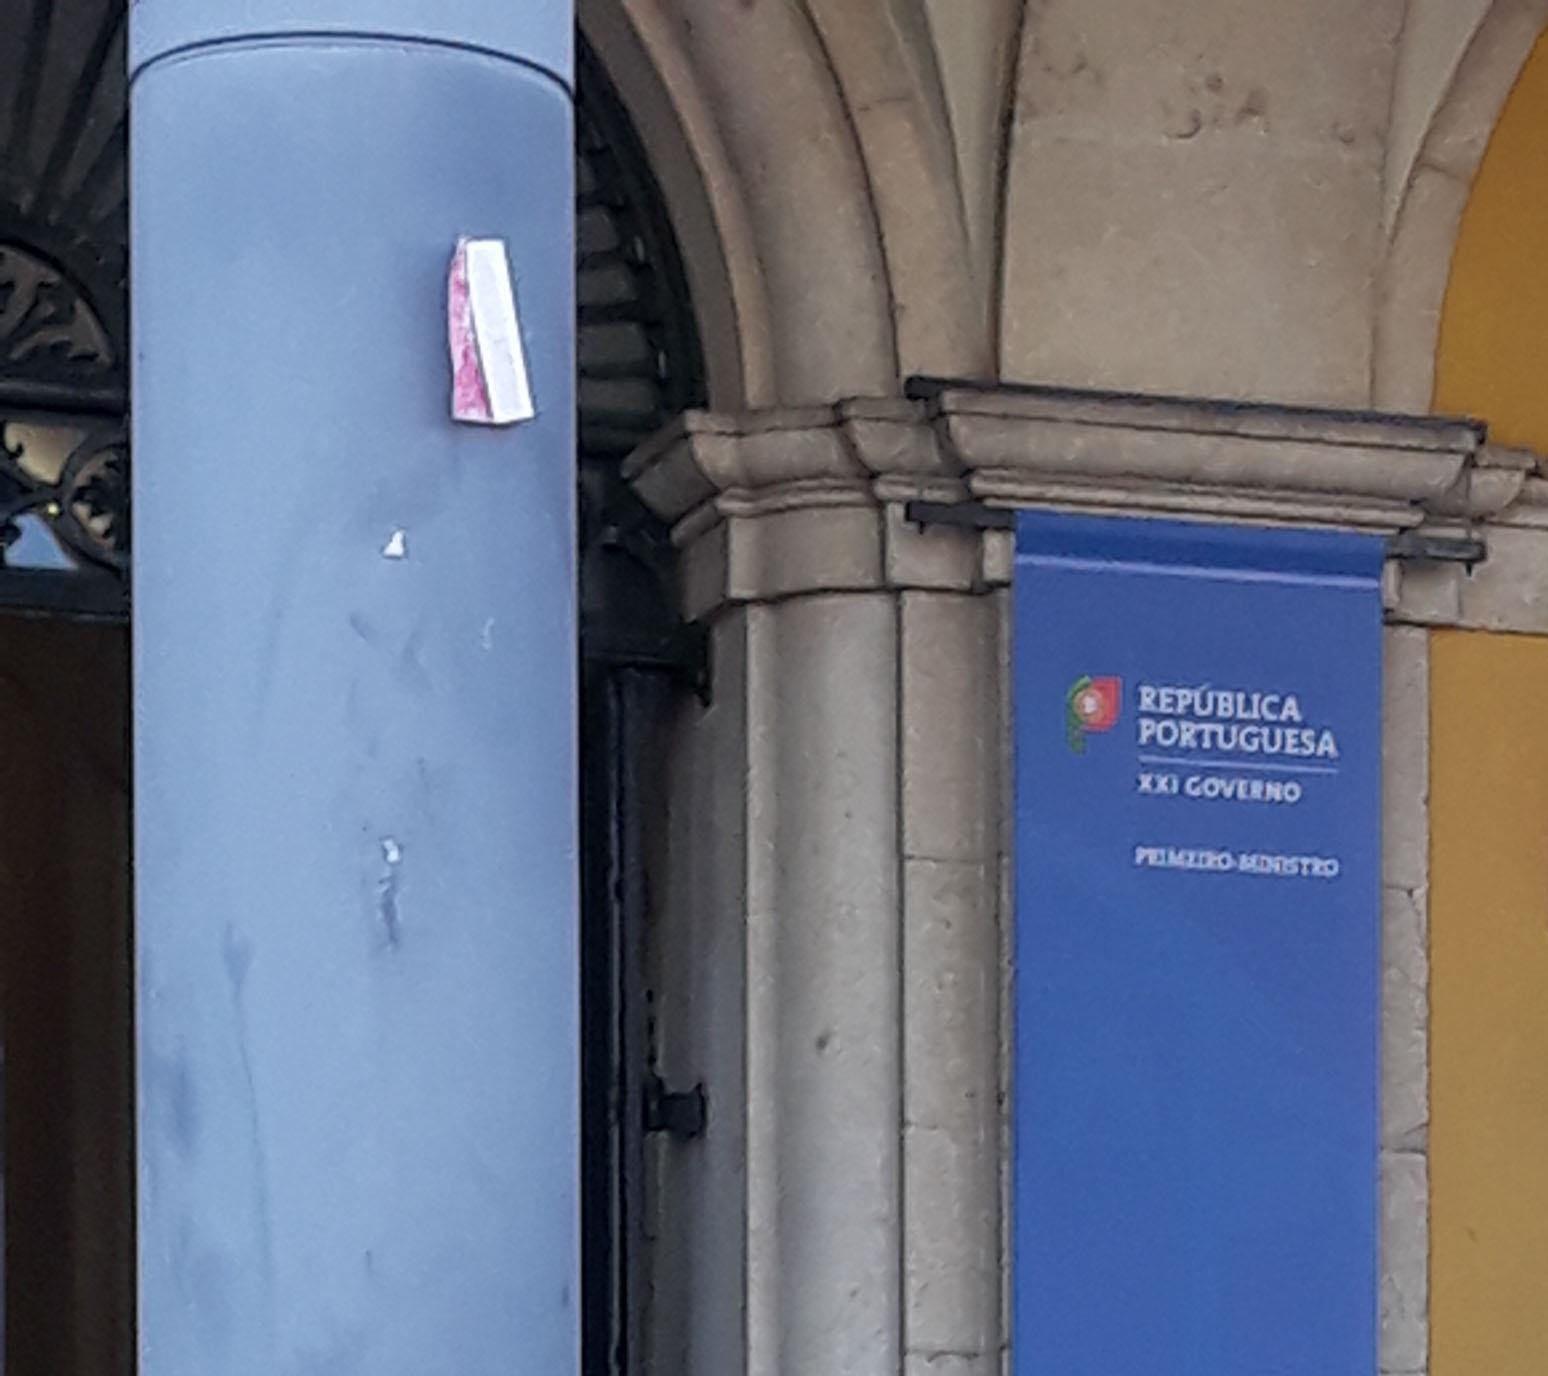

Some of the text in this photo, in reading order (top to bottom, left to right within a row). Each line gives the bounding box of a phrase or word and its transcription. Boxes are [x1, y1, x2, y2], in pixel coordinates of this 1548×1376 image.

[1138, 683, 1302, 721] REPÚBLICA
[1138, 718, 1338, 757] PORTUGUESA
[1138, 773, 1302, 802] XXI GOVERNO
